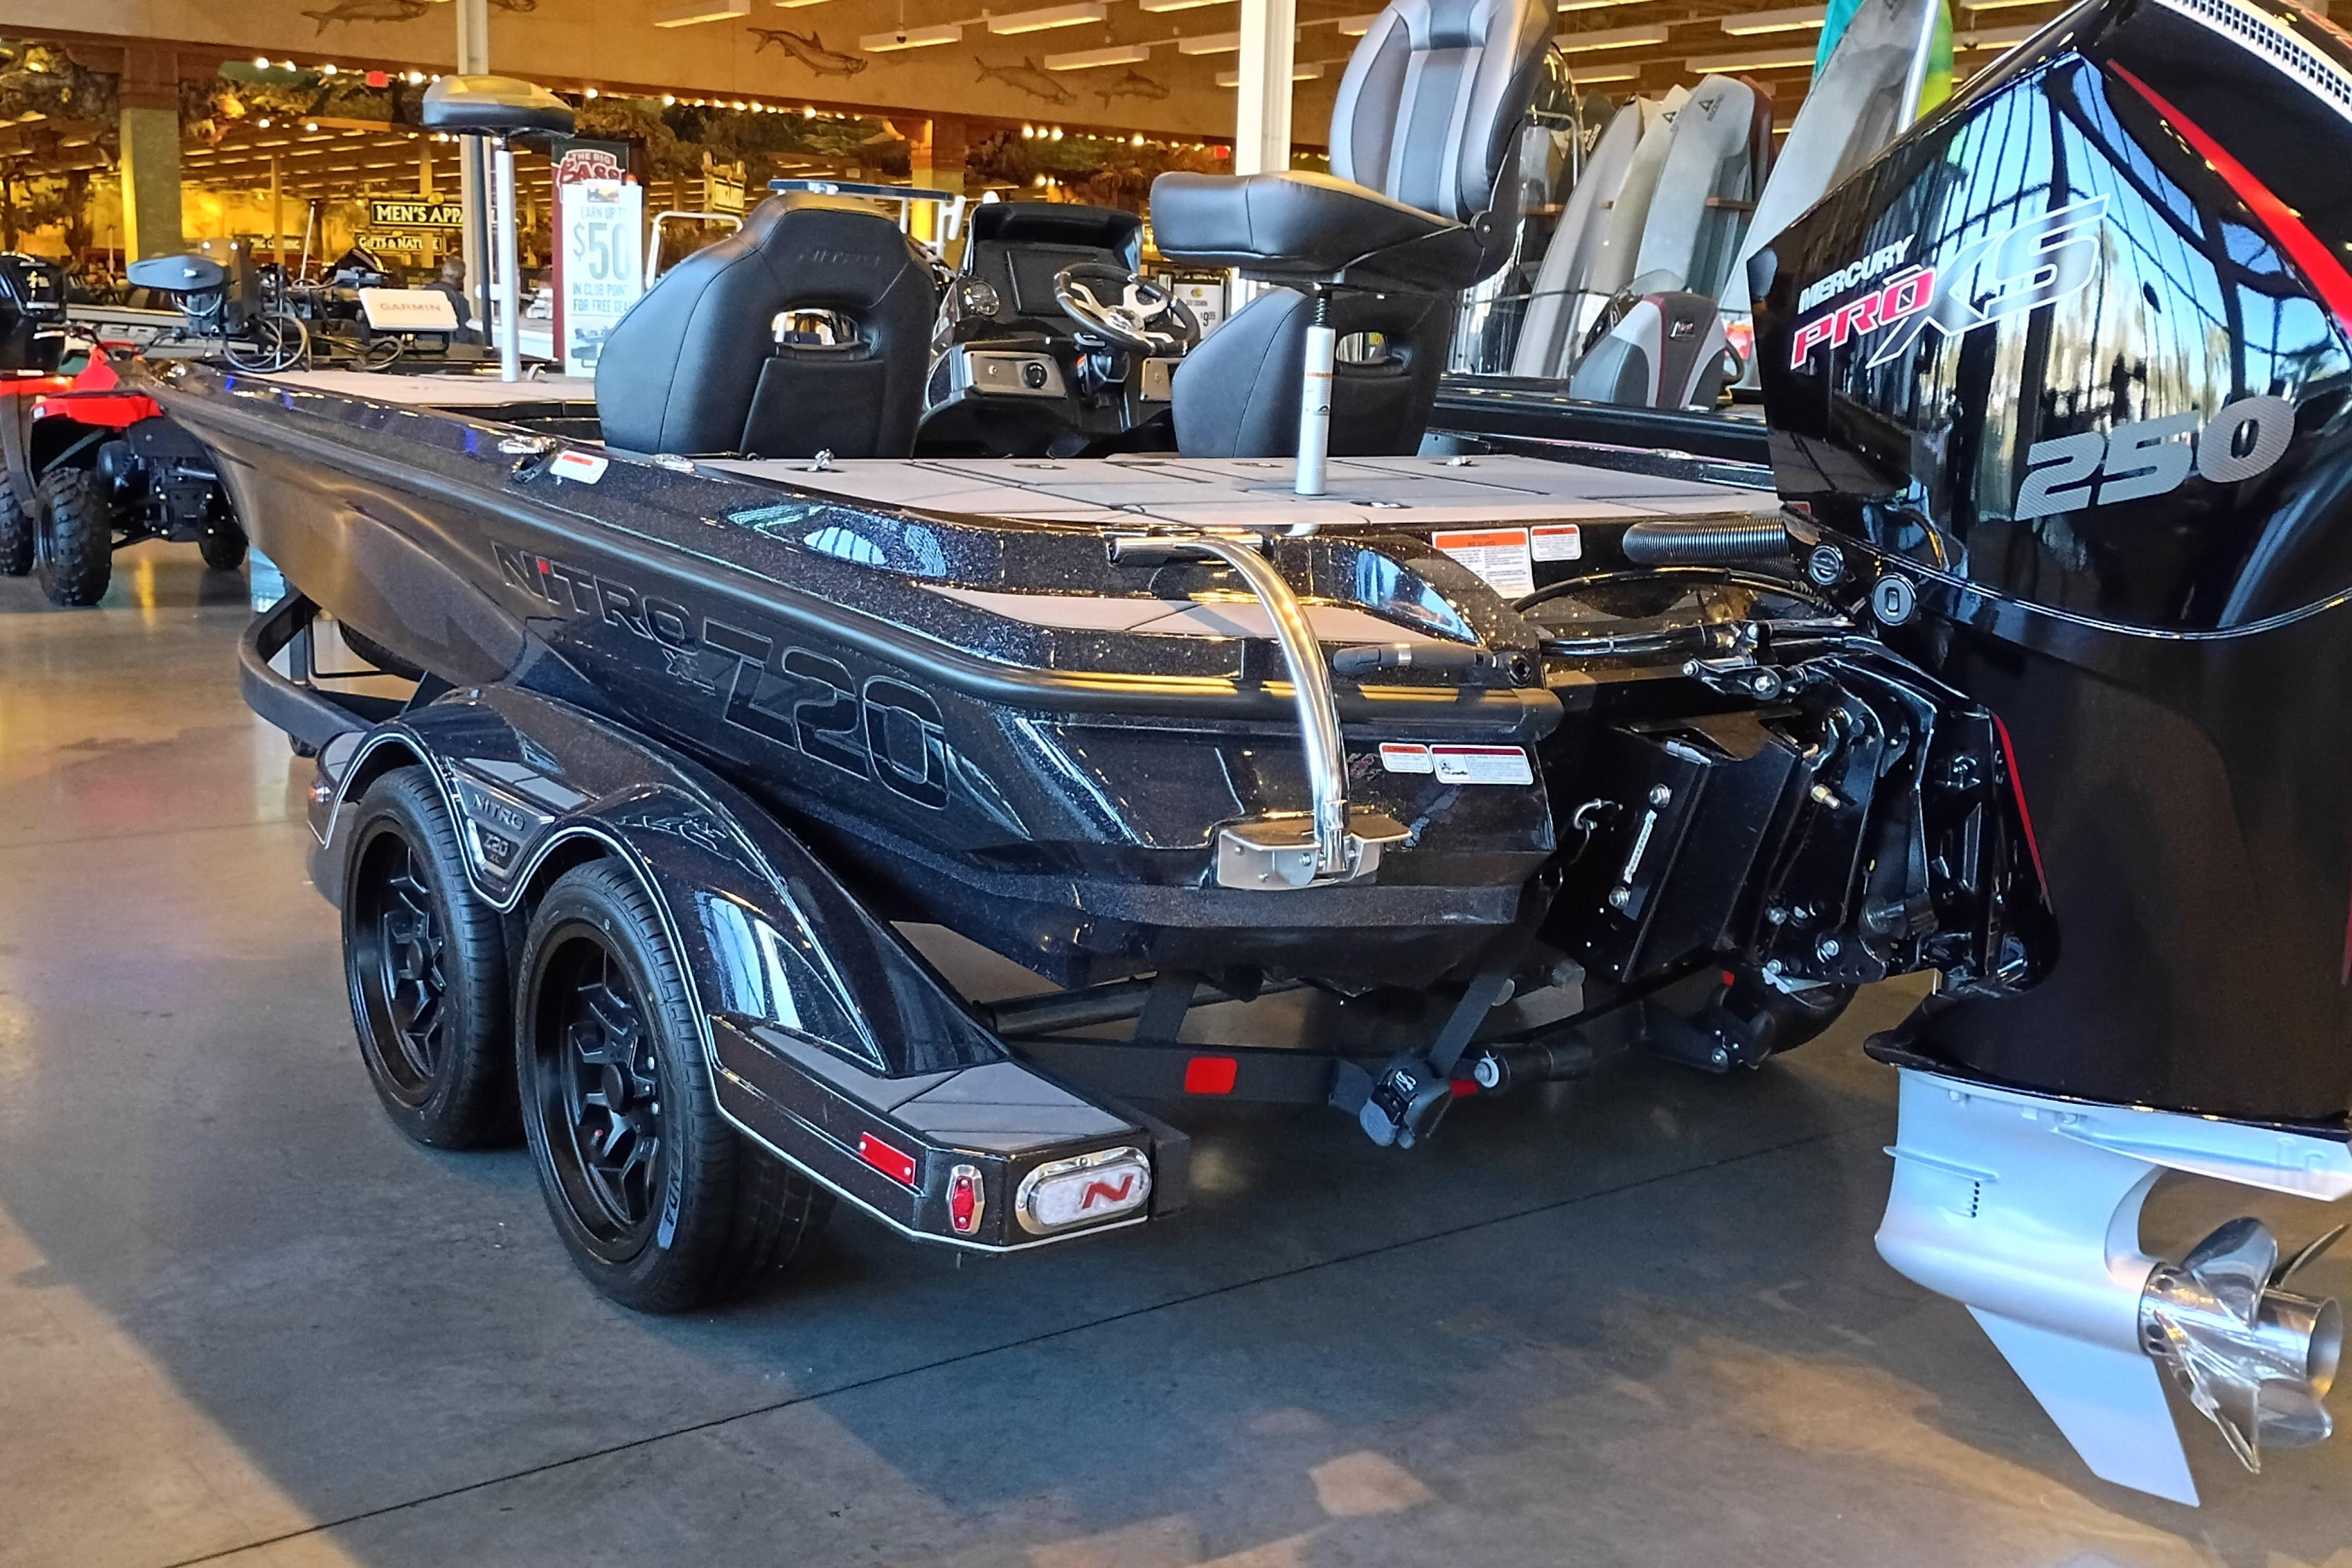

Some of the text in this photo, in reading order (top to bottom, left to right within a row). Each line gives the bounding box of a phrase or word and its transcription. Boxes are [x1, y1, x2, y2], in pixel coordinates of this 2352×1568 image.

[376, 205, 427, 222] MEN'S
[581, 206, 602, 218] EARN
[605, 206, 616, 219] UP
[573, 221, 631, 281] $50
[1797, 234, 1915, 315] MERCURY
[380, 302, 442, 312] GARMIN
[573, 282, 633, 297] IN CLUB POINT
[573, 299, 589, 312] FOR
[592, 299, 611, 313] FREE
[1790, 267, 1936, 370] PRO
[2014, 395, 2296, 522] 250
[491, 540, 699, 656] NITRO
[702, 616, 950, 811] Z20
[472, 792, 526, 832] NITRO
